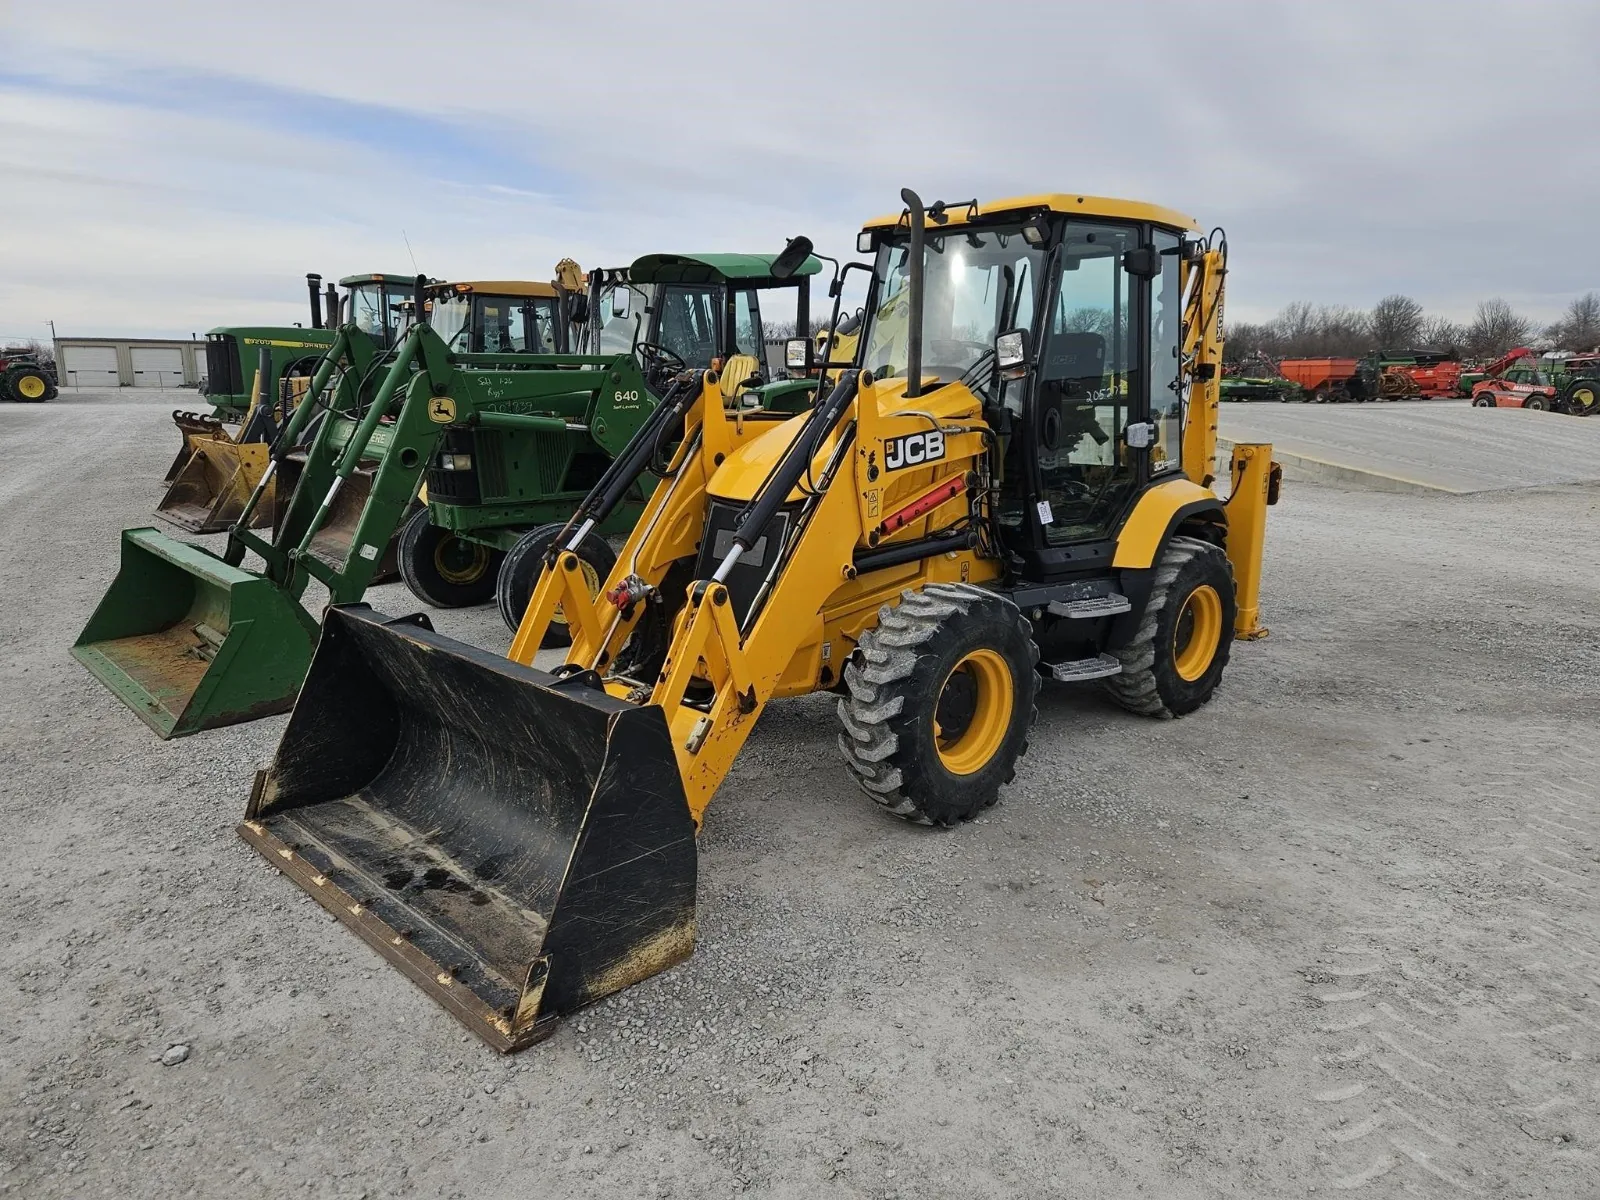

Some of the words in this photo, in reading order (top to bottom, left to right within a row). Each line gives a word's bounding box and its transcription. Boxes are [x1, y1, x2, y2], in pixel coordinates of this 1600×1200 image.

[614, 390, 639, 402] 640
[886, 431, 945, 469] JCB
[1153, 460, 1165, 472] 3CX
